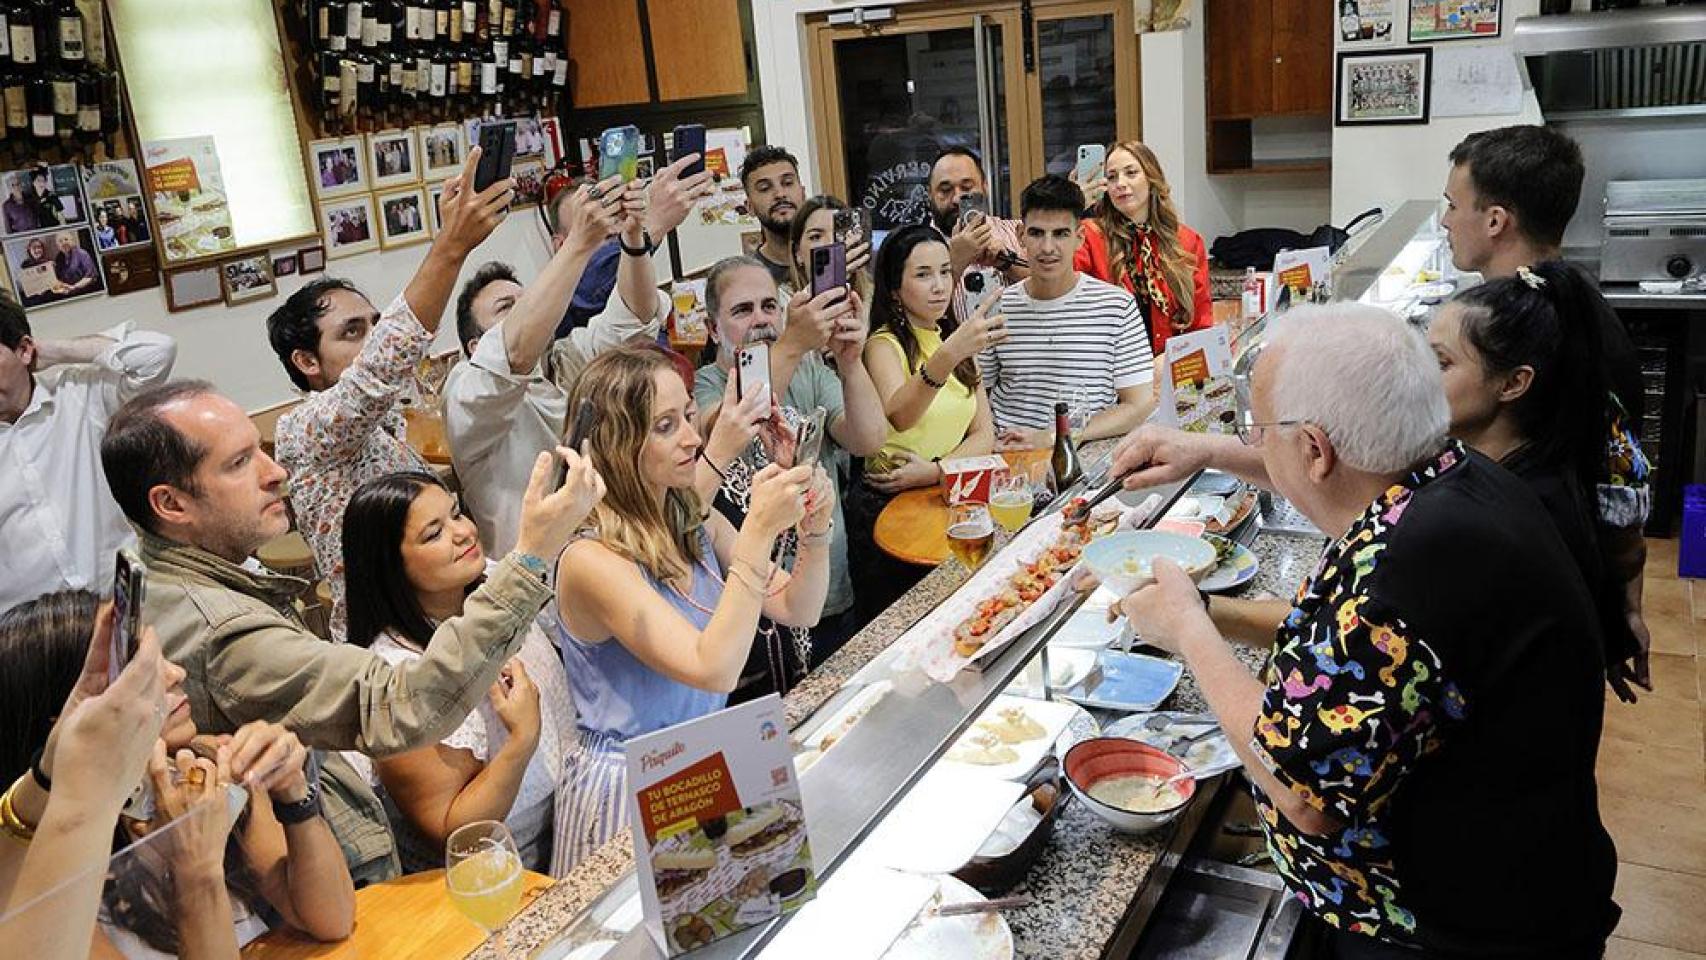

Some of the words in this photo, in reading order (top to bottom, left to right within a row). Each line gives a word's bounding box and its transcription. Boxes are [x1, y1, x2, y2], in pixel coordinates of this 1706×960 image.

[647, 790, 662, 801] TU
[662, 768, 722, 797] BOCADILLO
[650, 800, 666, 813] DE
[666, 782, 721, 806] TERNASCO
[652, 812, 669, 825] DE
